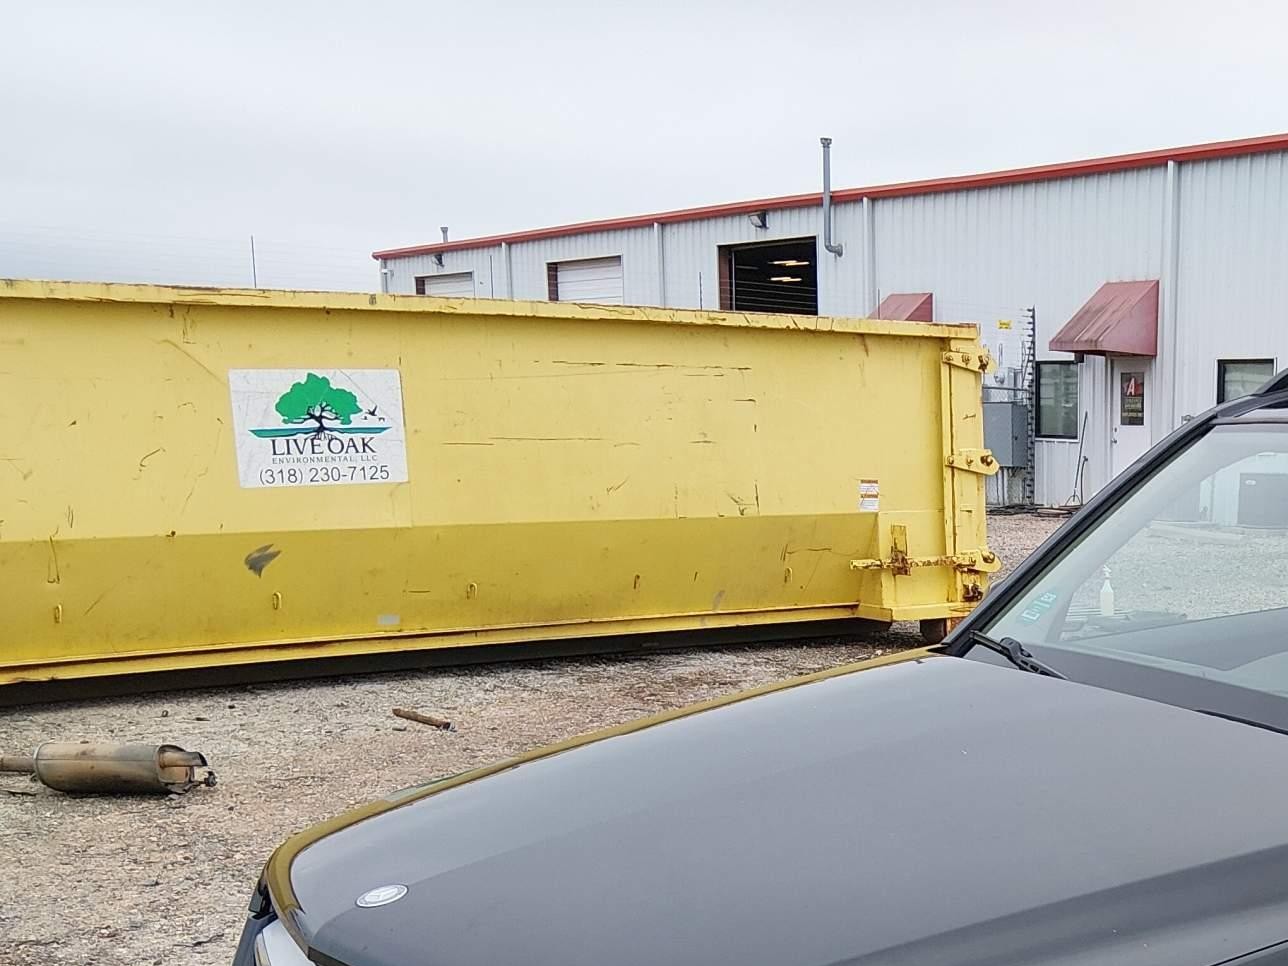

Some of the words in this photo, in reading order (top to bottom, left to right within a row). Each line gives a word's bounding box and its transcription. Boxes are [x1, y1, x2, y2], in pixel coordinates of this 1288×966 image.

[271, 438, 324, 455] LIVE
[327, 437, 376, 455] OAK
[259, 468, 303, 485] (318)
[309, 465, 390, 483] 230-7125
